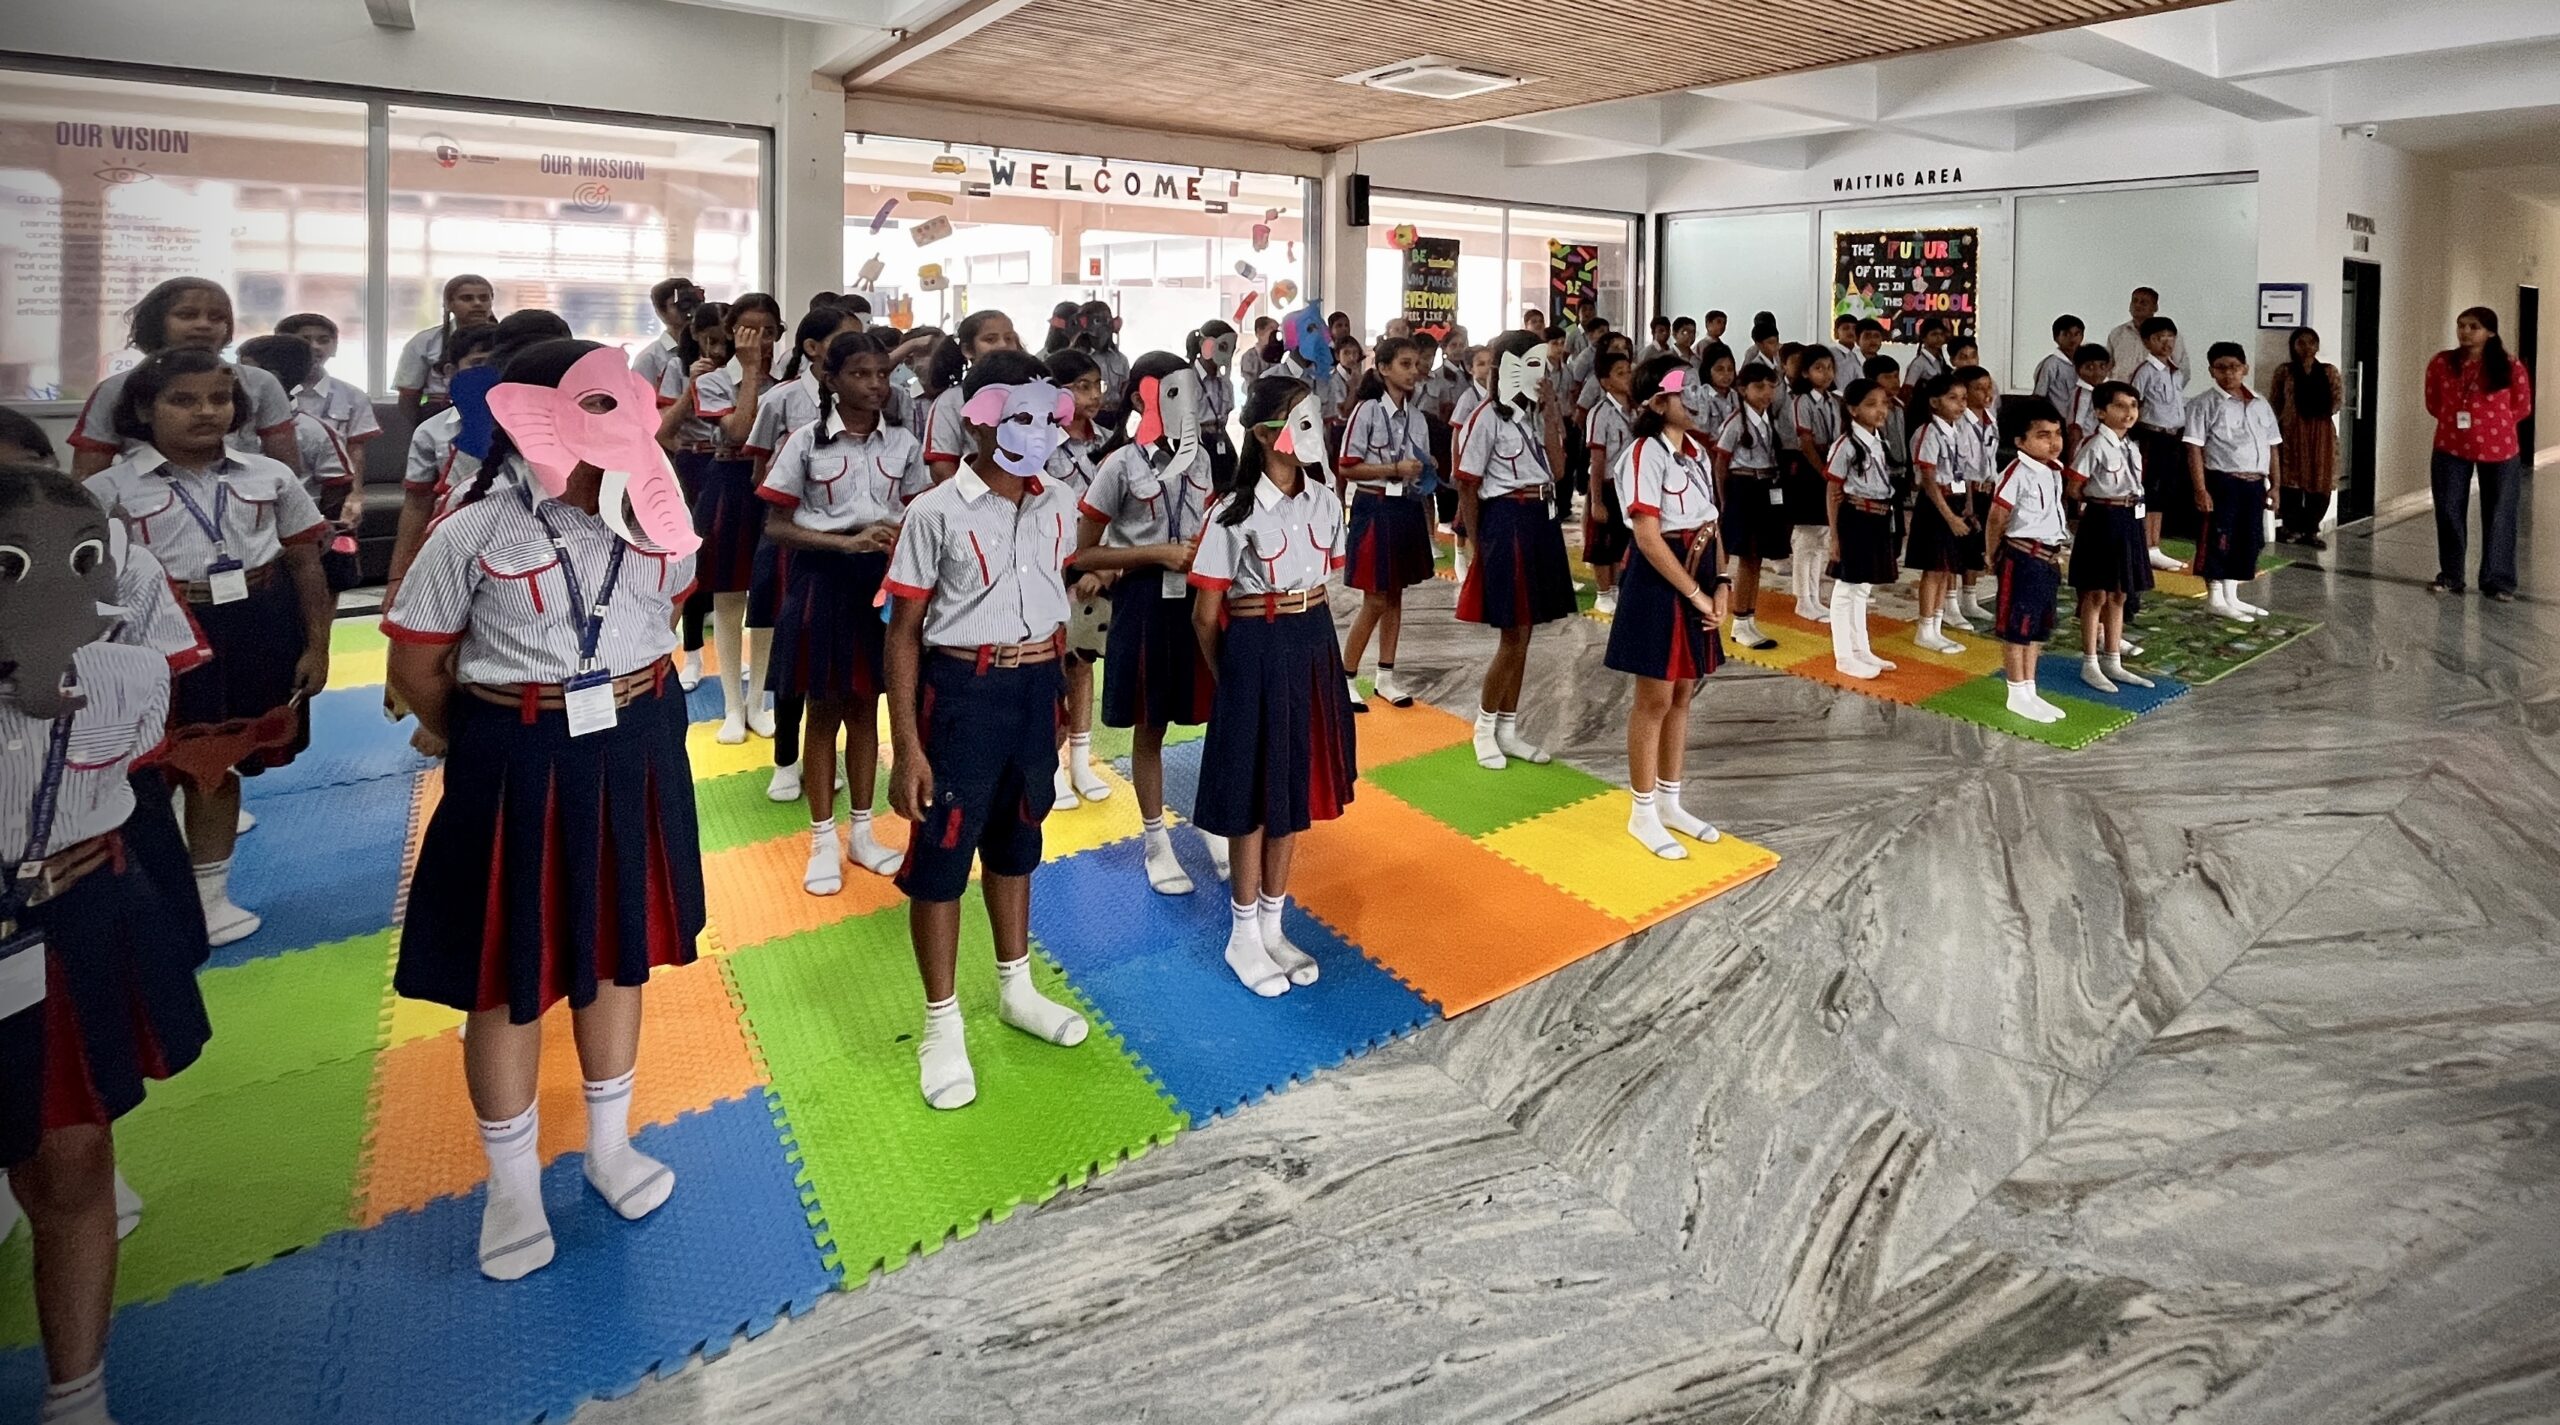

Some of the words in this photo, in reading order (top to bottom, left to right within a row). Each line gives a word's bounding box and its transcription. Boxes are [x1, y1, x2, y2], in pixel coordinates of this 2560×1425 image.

[56, 121, 102, 148] OUR
[111, 125, 189, 153] VISION
[540, 153, 572, 175] OUR
[578, 157, 645, 181] MISSION
[989, 159, 1203, 200] WELCOME
[1833, 172, 1904, 192] WAITING
[1915, 167, 1962, 186] AREA
[1412, 248, 1428, 263] BE
[1851, 243, 1875, 257] THE
[1887, 240, 1962, 260] FUTURE
[1855, 265, 1871, 278] OF
[1873, 265, 1897, 278] THE
[1566, 280, 1582, 295] BE
[1877, 281, 1890, 291] IS
[1891, 281, 1905, 291] IN
[1404, 290, 1457, 310] EVERYBODY
[1883, 297, 1903, 307] THIS
[1902, 292, 1973, 312] SCHOOL
